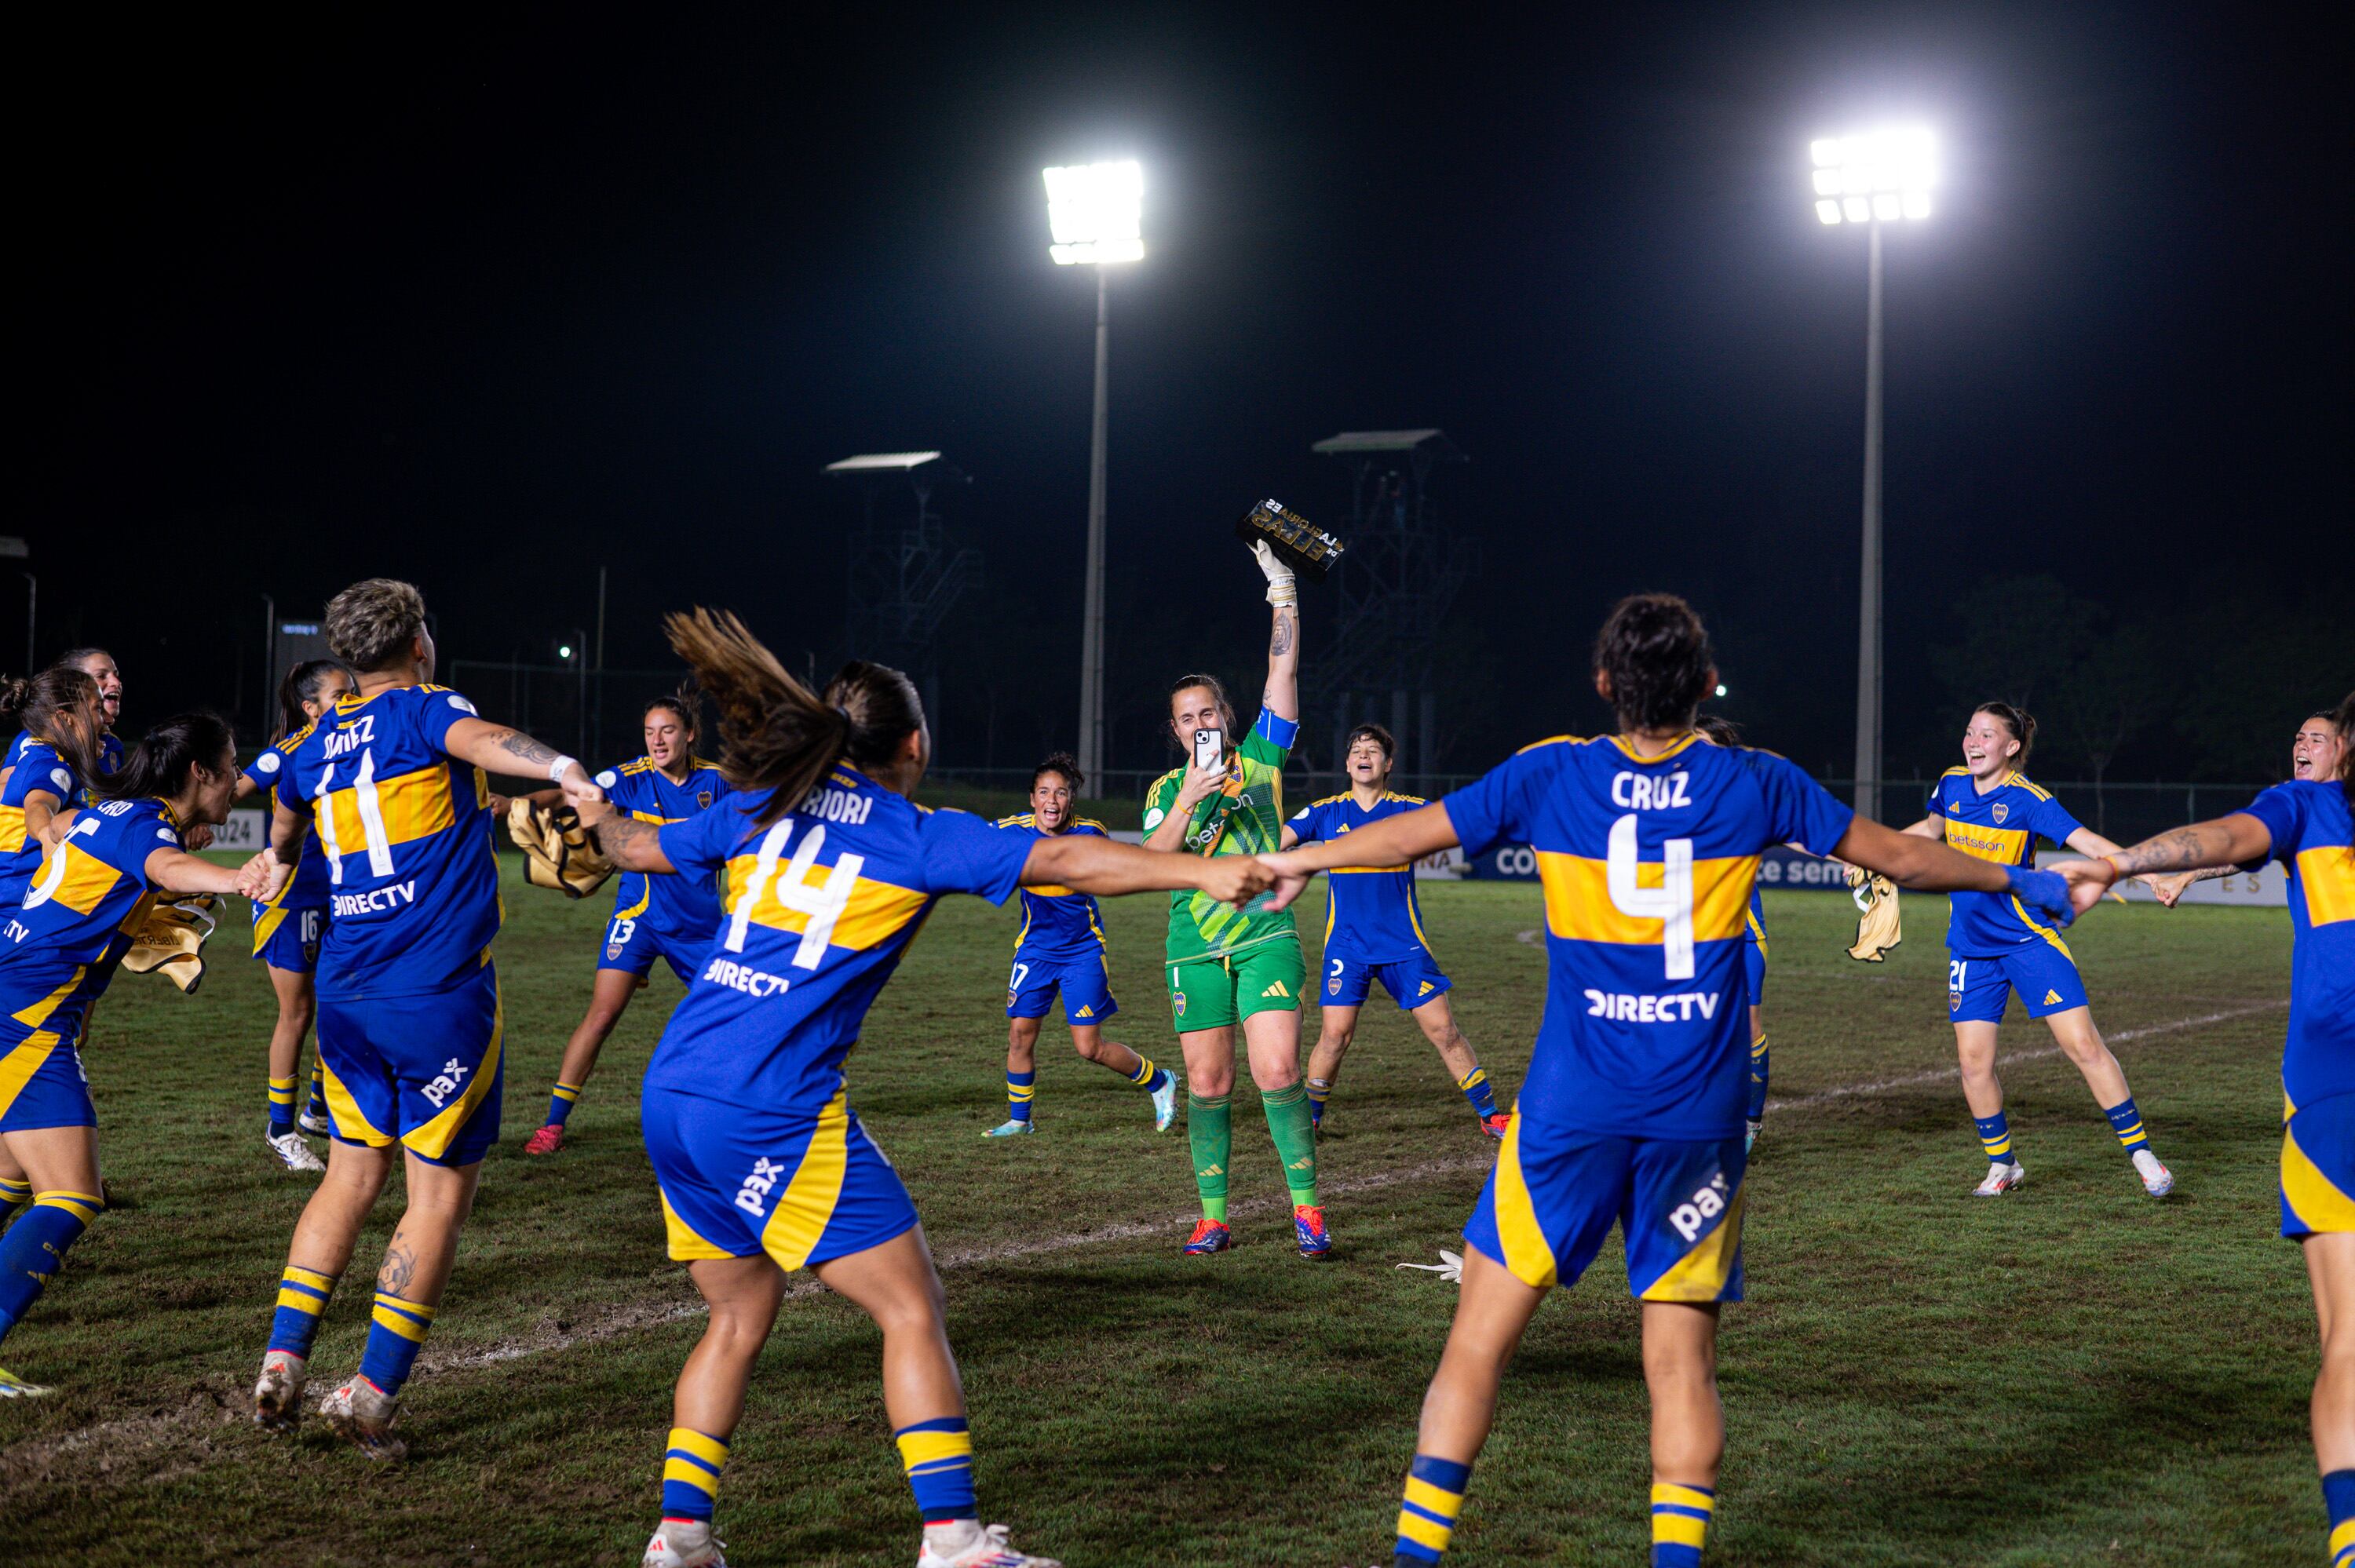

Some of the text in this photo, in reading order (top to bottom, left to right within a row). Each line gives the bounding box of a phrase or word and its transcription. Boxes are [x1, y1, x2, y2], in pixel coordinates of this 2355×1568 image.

[801, 786, 873, 825] RIORI
[1612, 771, 1691, 810] CRUZ
[213, 819, 251, 843] 024
[315, 748, 395, 884] 11
[1949, 831, 2004, 852] betsson
[1496, 848, 1540, 874] CO
[330, 881, 414, 917] DIRECTV
[724, 819, 864, 970] 14
[1608, 813, 1694, 979] 4
[301, 910, 319, 942] 16
[609, 919, 636, 944] 13
[1010, 961, 1028, 990] 17
[1174, 966, 1179, 987] 1
[1949, 960, 1967, 991] 21
[1584, 989, 1719, 1023] DIRECTV
[421, 1058, 468, 1108] pax
[735, 1156, 784, 1217] pax
